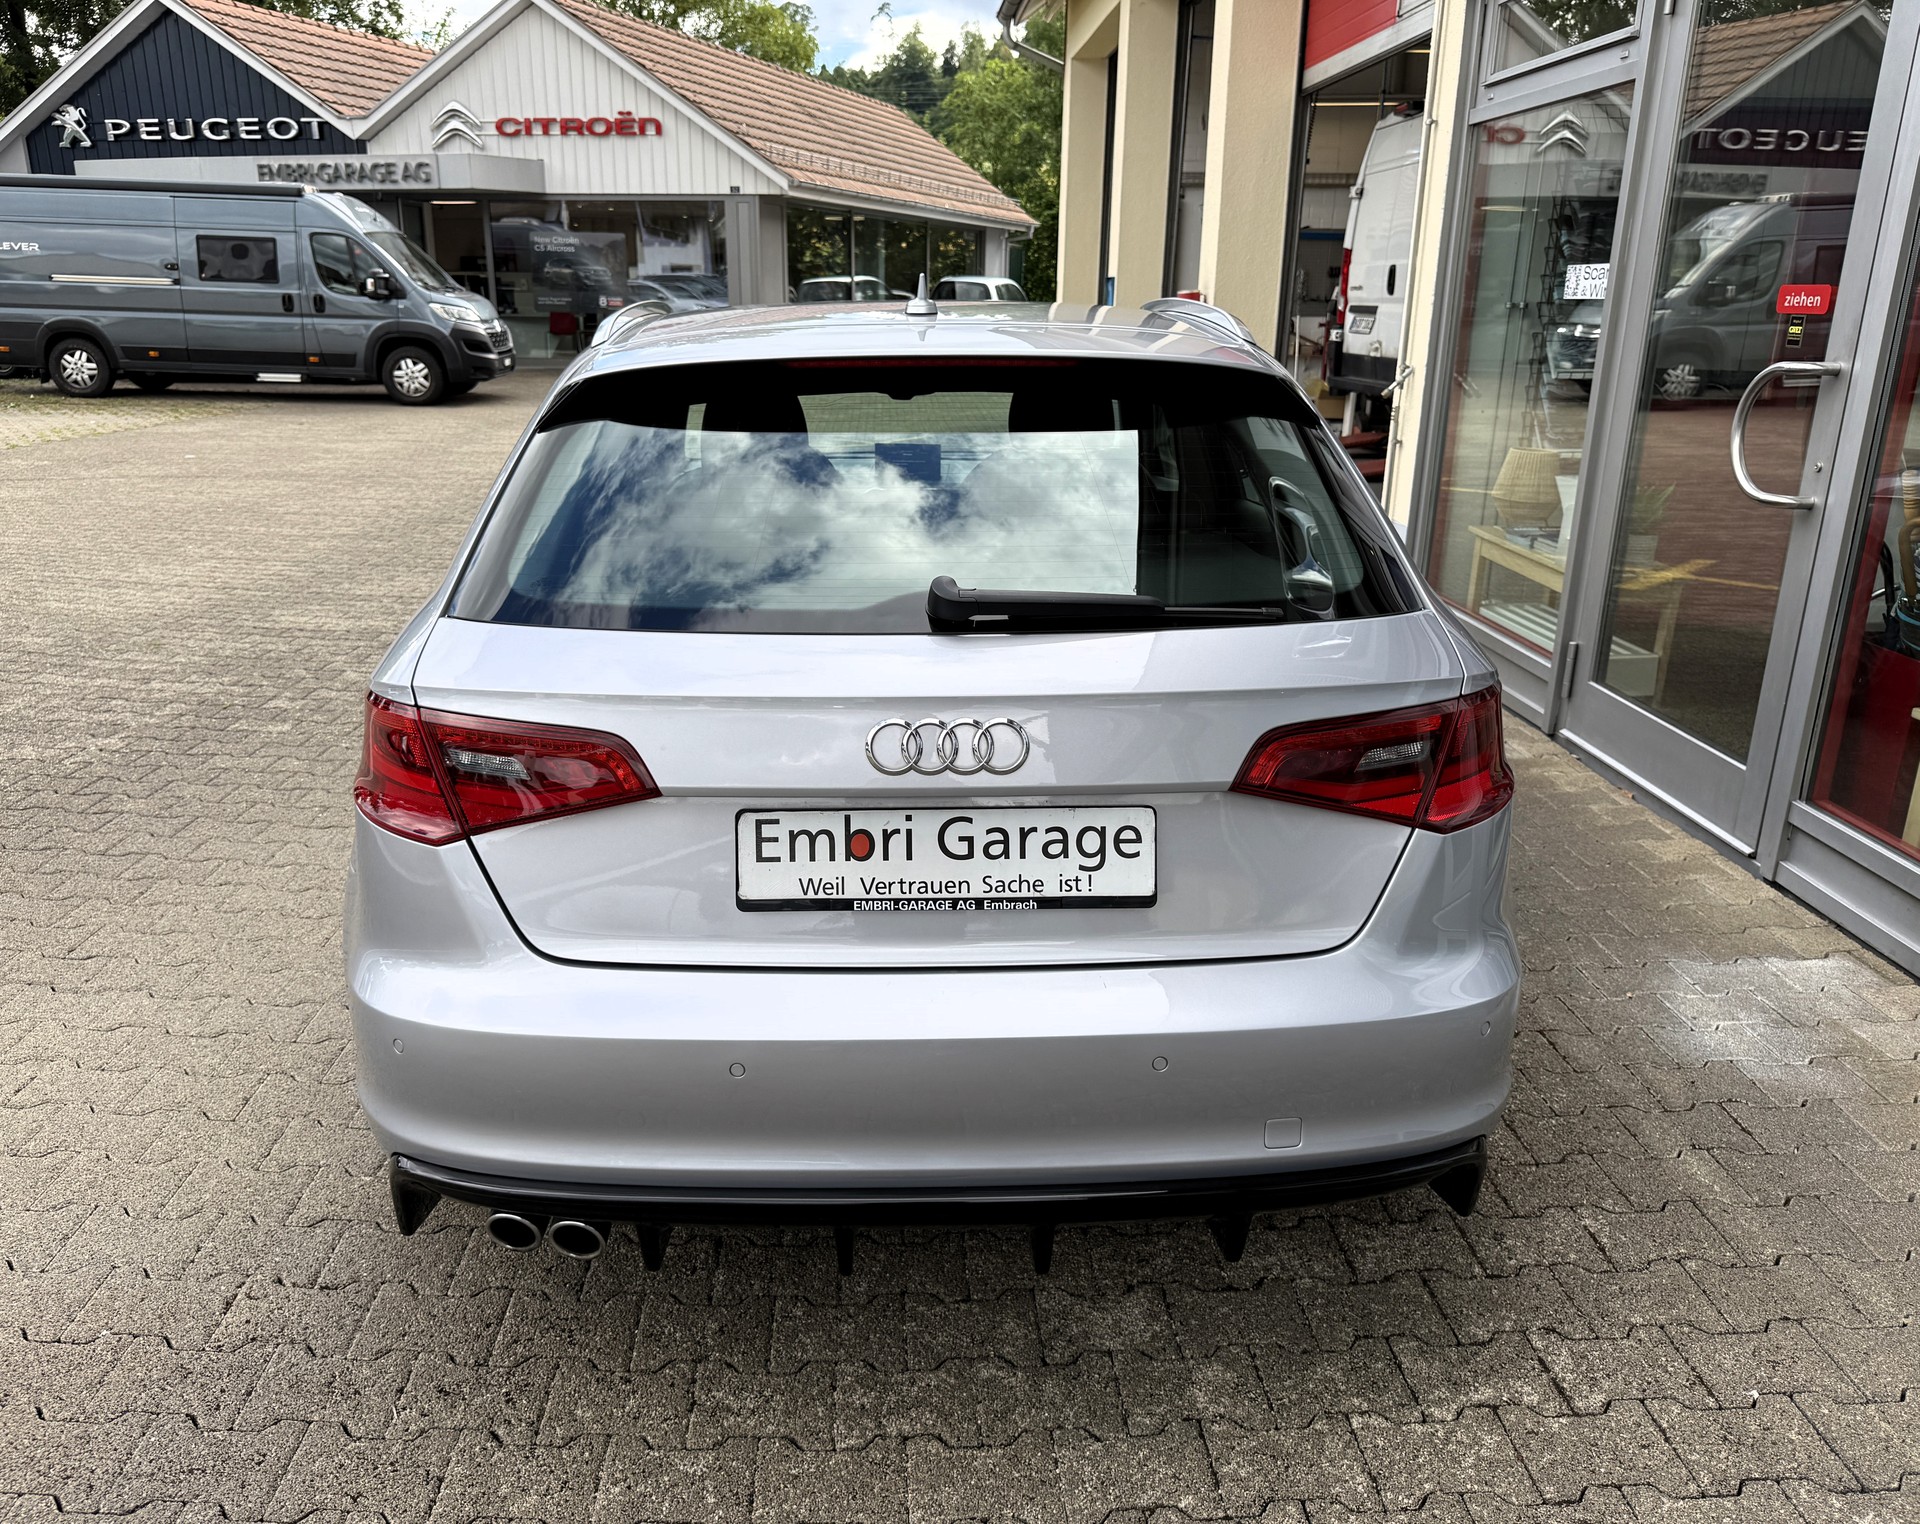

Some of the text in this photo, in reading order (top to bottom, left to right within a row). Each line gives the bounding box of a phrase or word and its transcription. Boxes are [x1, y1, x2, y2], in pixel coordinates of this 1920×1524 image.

[104, 117, 326, 142] PEUGEOT
[256, 161, 432, 184] EMBRI-GARAGE AG
[0, 241, 40, 251] EVER
[1784, 291, 1821, 307] ziehen
[754, 814, 1143, 872] Embri Garage
[799, 875, 846, 897] Weil
[859, 876, 972, 897] Vertrauen
[981, 874, 1045, 894] Sache
[853, 899, 1038, 911] EMBRI-GARAGE AG Embrach
